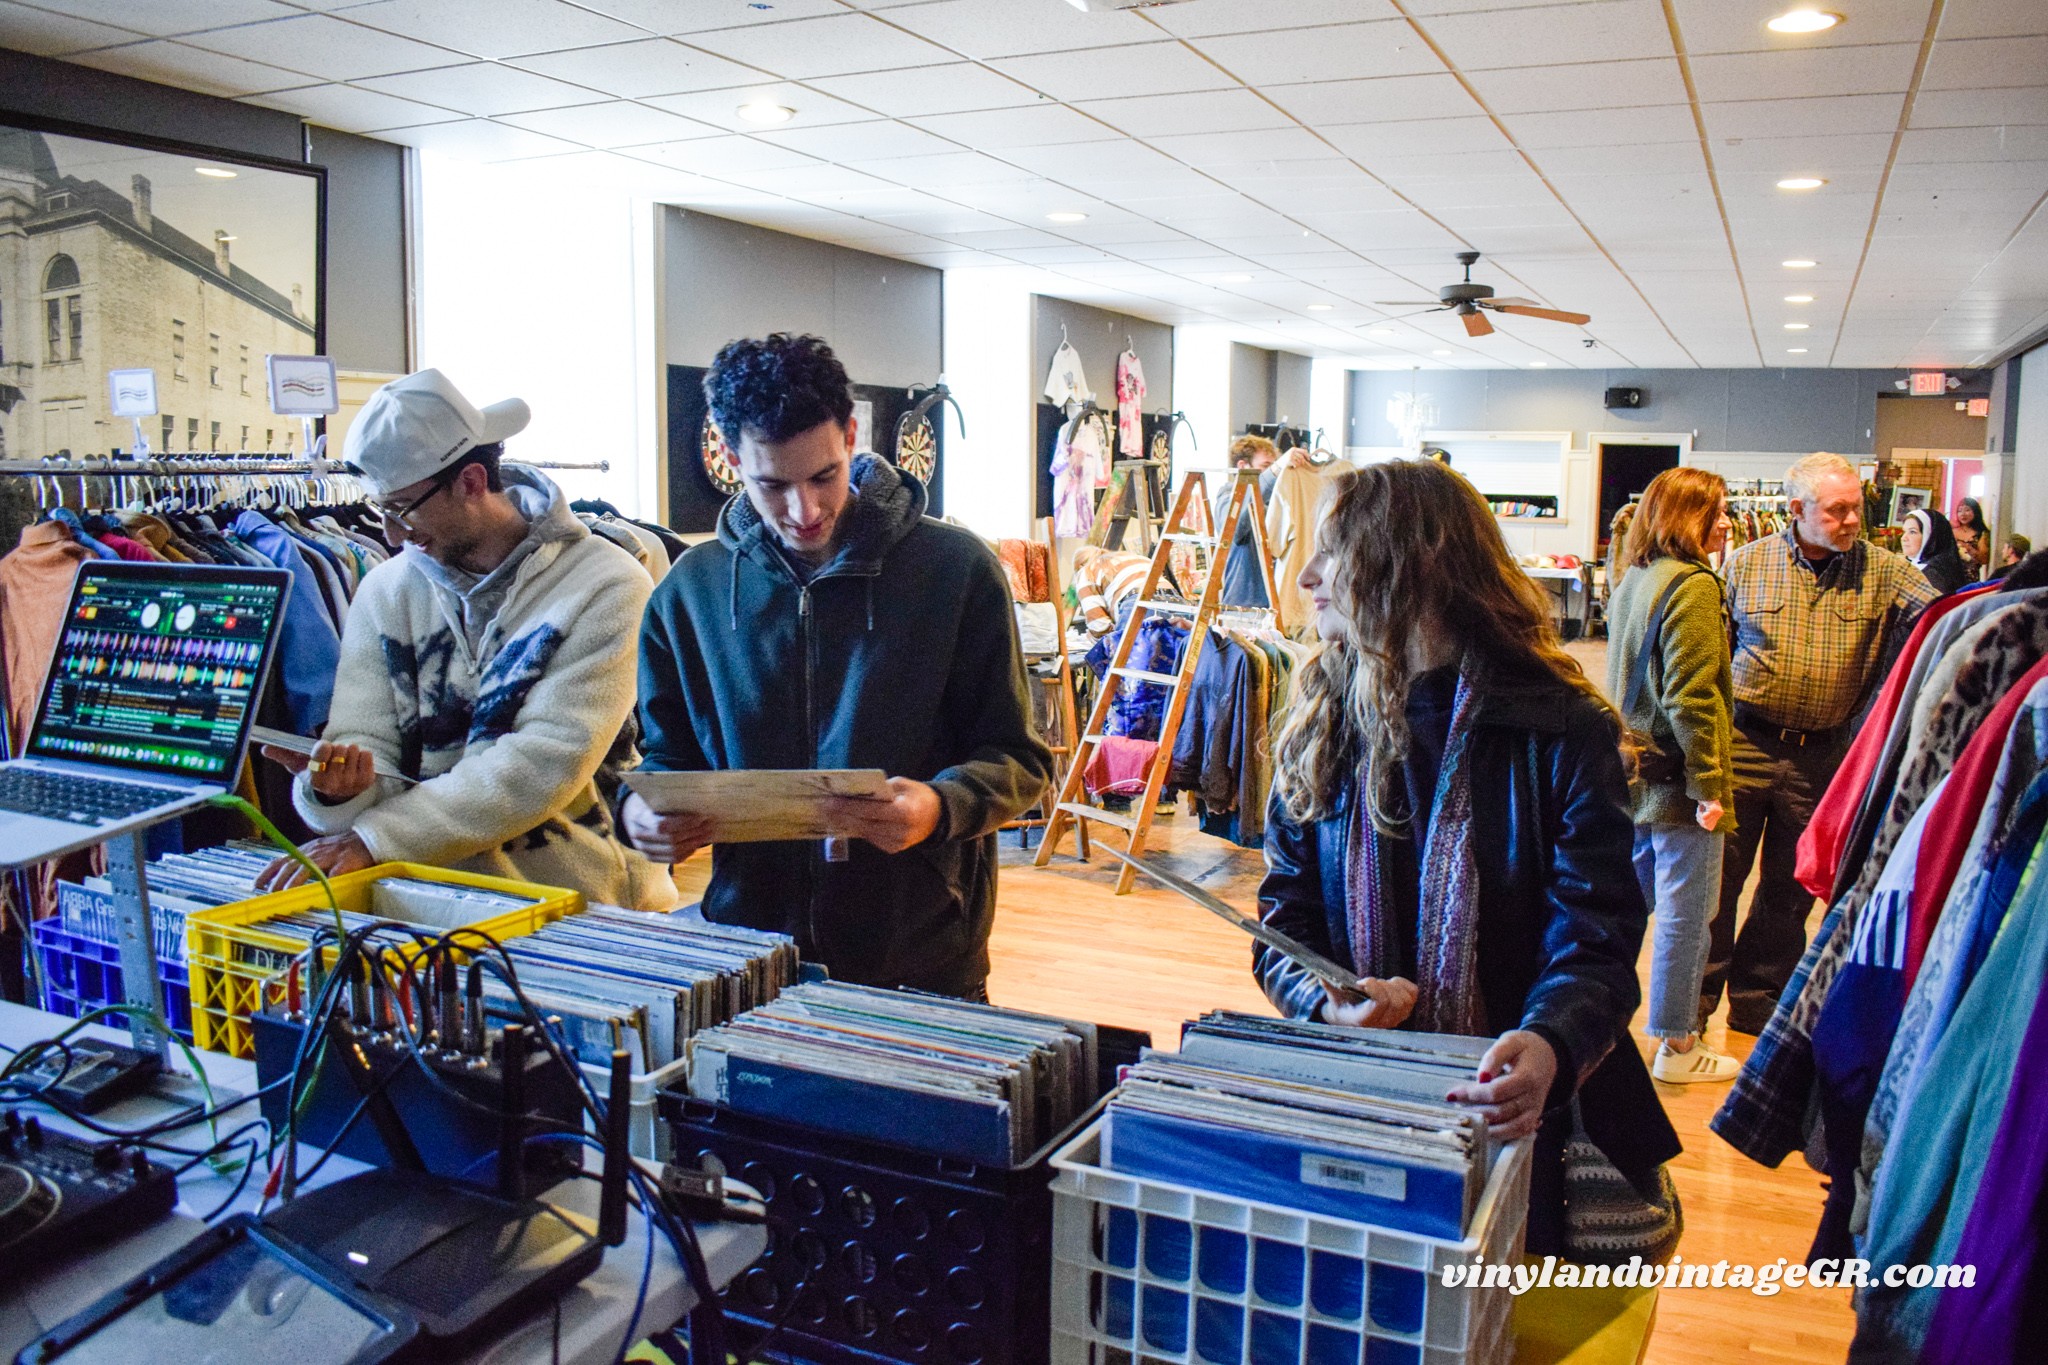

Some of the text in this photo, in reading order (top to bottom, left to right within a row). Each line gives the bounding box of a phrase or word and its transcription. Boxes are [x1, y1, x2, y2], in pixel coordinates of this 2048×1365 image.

[1917, 373, 1942, 392] EXIT
[63, 890, 94, 913] ABBA
[95, 897, 116, 918] Gre
[255, 949, 289, 971] DIA
